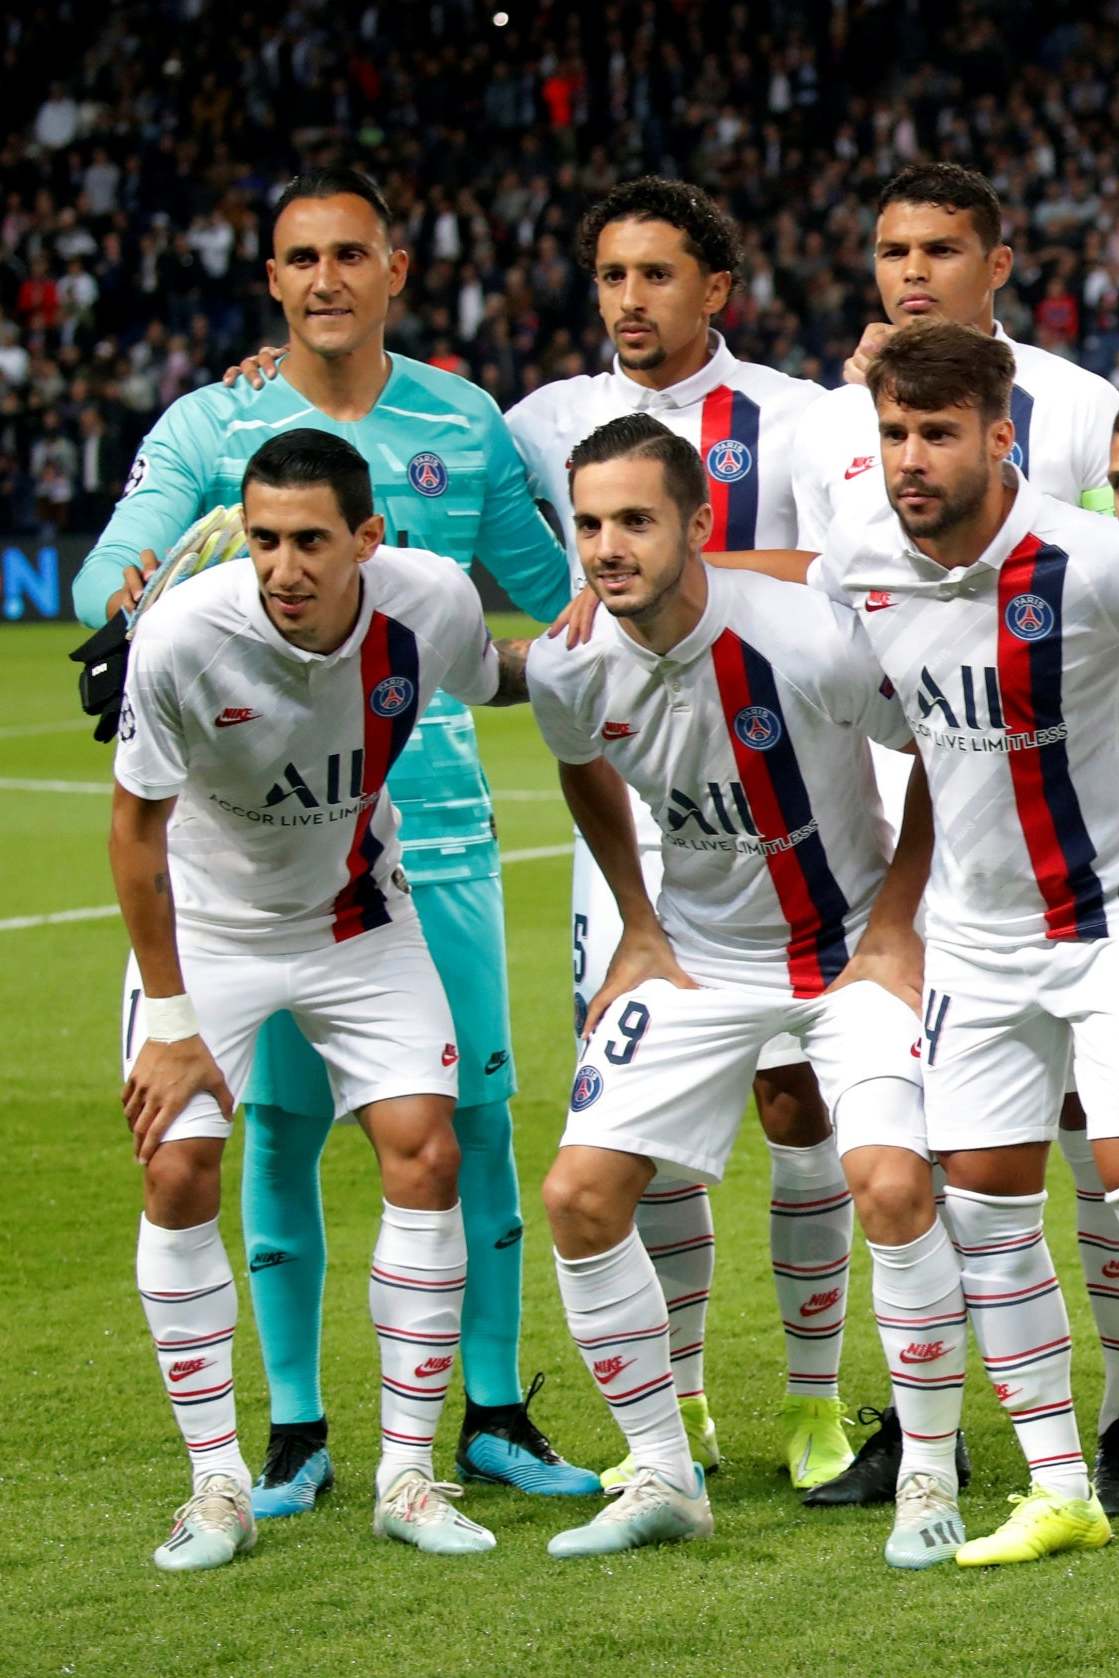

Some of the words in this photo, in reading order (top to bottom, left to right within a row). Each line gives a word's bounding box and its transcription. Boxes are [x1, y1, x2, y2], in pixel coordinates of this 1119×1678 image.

[715, 441, 744, 453] PARIS
[1014, 596, 1044, 610] PARIS
[222, 707, 252, 720] NIKE
[971, 722, 1068, 753] LIMITLESS
[281, 813, 324, 827] LIVE
[690, 839, 733, 852] LIVE
[736, 817, 819, 858] LIMITLESS
[604, 1000, 650, 1065] 9
[811, 1288, 840, 1307] NIKE
[909, 1340, 944, 1357] NIKE
[174, 1358, 206, 1372] NIKE
[424, 1355, 453, 1370] NIKE
